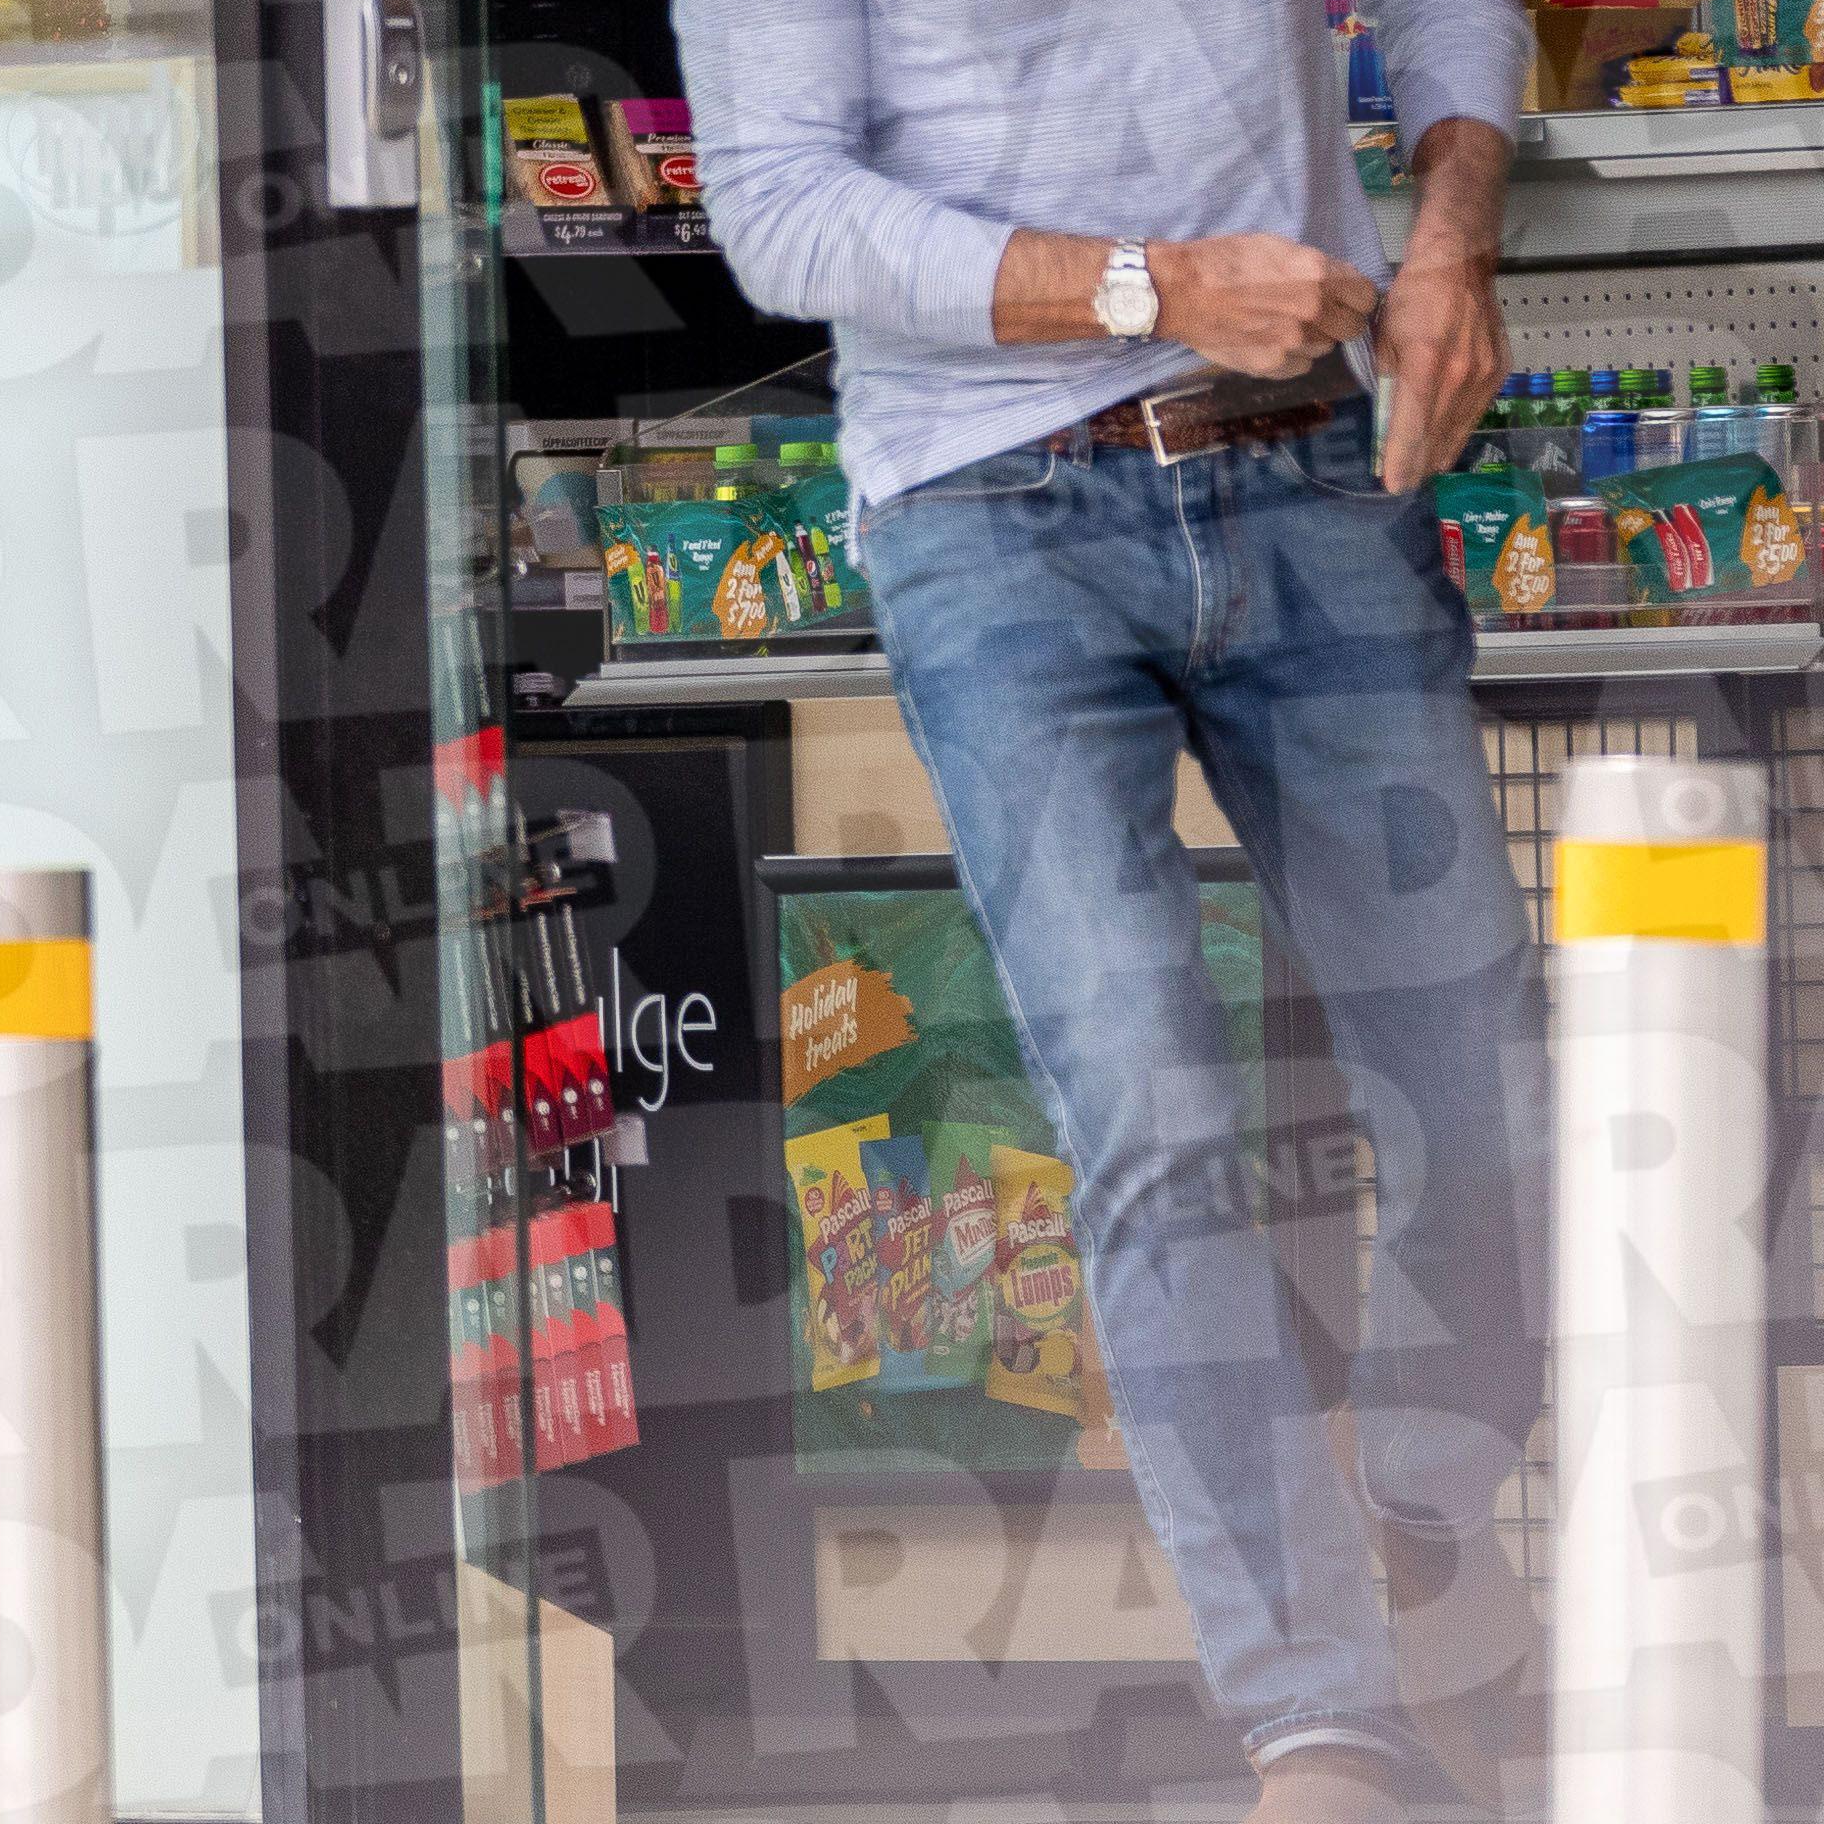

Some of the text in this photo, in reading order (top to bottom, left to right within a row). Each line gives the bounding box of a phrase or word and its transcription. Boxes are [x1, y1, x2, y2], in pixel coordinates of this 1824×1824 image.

[789, 976, 858, 1041] Holiday
[805, 1013, 858, 1072] treats
[1006, 1214, 1067, 1248] Pascall
